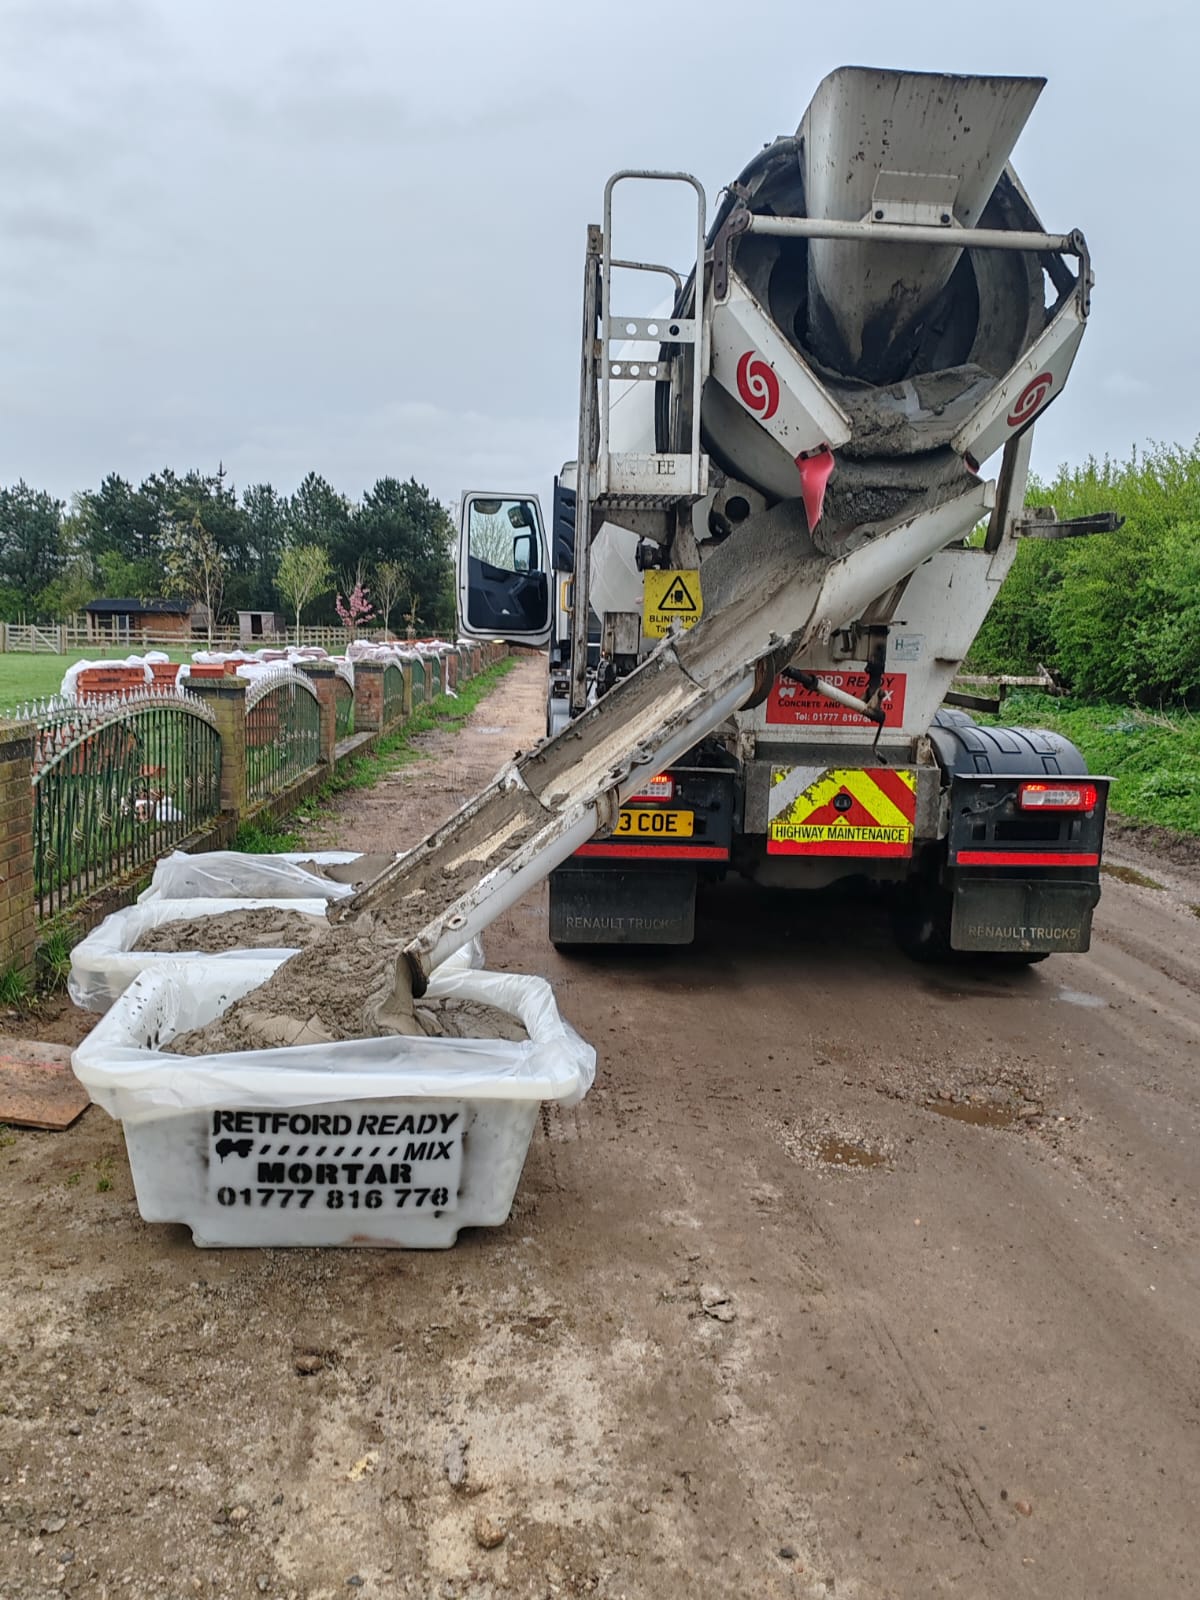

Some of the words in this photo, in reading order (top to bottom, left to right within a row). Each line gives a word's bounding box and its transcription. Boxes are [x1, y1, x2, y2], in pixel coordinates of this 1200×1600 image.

[680, 615, 701, 623] SPO
[779, 674, 843, 687] REORD
[812, 713, 839, 722] 01777
[842, 713, 872, 723] 8167
[638, 813, 678, 832] COE
[776, 826, 824, 840] HIGHWAY
[827, 827, 905, 842] MAINTENANCE
[566, 917, 625, 929] RENAULT
[968, 927, 1026, 939] RENAULT
[1030, 927, 1077, 940] TRUCKS
[213, 1111, 351, 1136] RETFORD
[357, 1113, 459, 1136] READY
[403, 1141, 454, 1162] MIX
[257, 1163, 412, 1185] MORTAR
[217, 1187, 314, 1209] 01777
[326, 1190, 382, 1210] 816
[394, 1187, 449, 1208] 778
